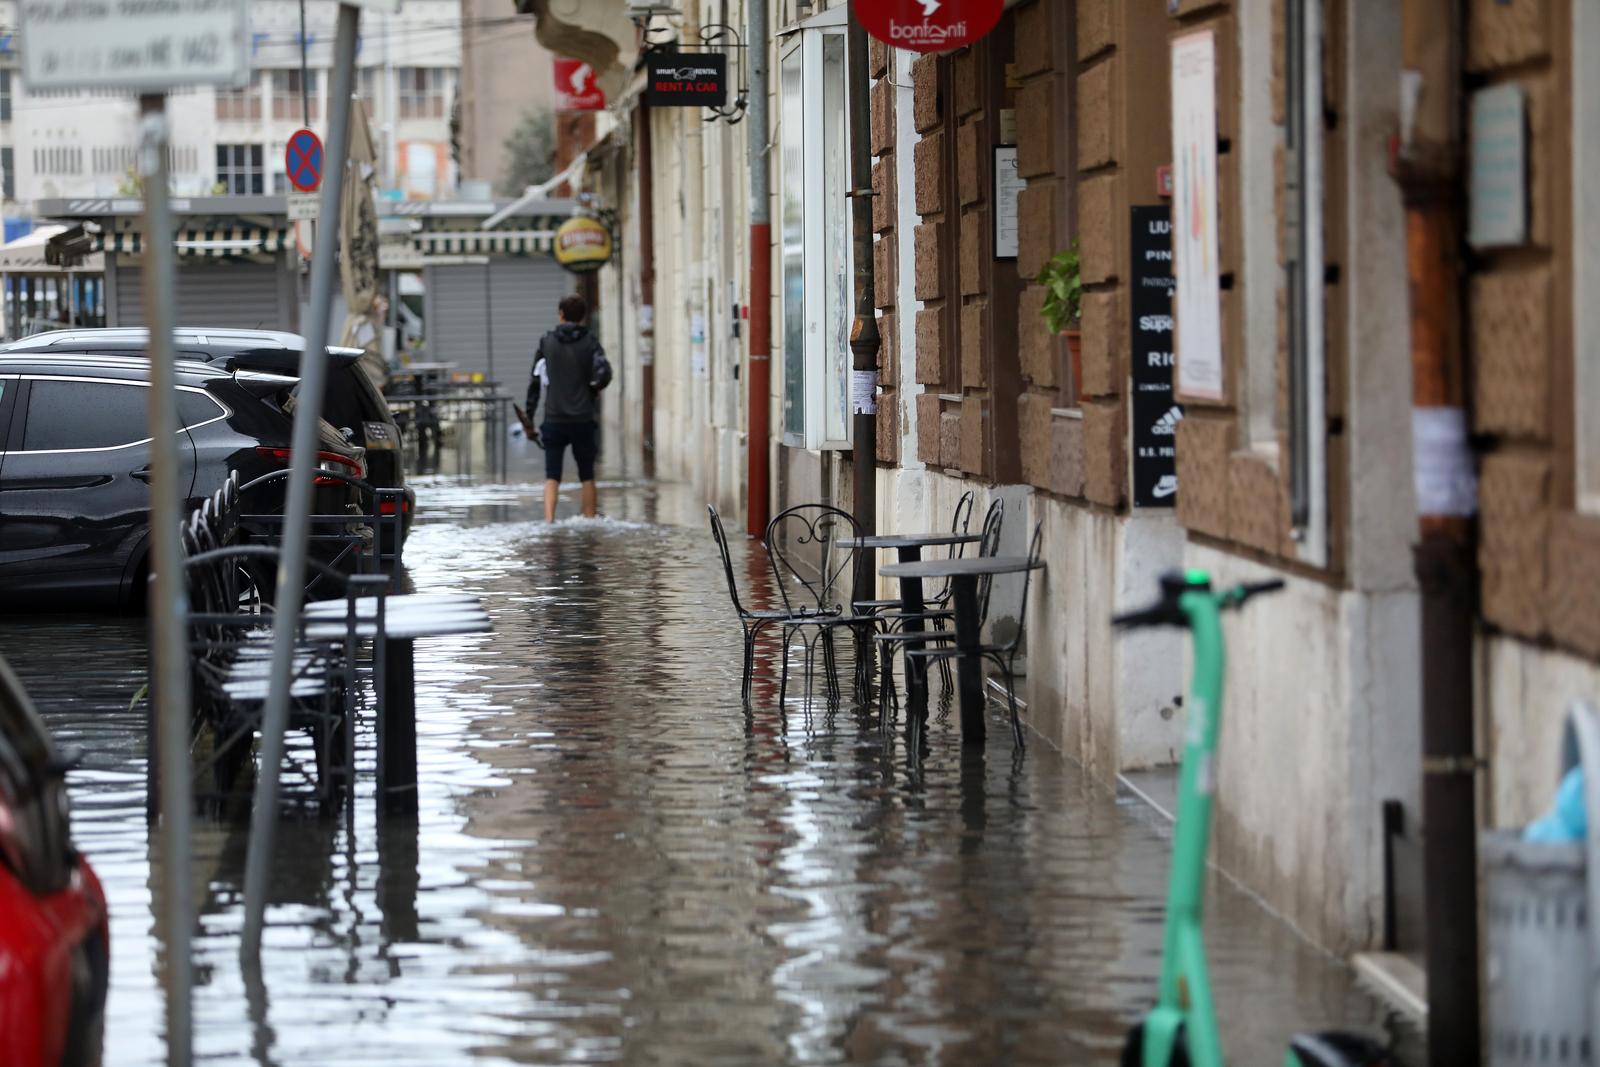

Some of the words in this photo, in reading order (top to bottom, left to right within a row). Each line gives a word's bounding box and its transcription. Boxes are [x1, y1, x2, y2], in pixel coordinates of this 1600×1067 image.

[889, 17, 966, 39] bonfanti
[655, 81, 683, 92] RENT
[686, 81, 694, 92] A
[696, 81, 718, 92] CAR
